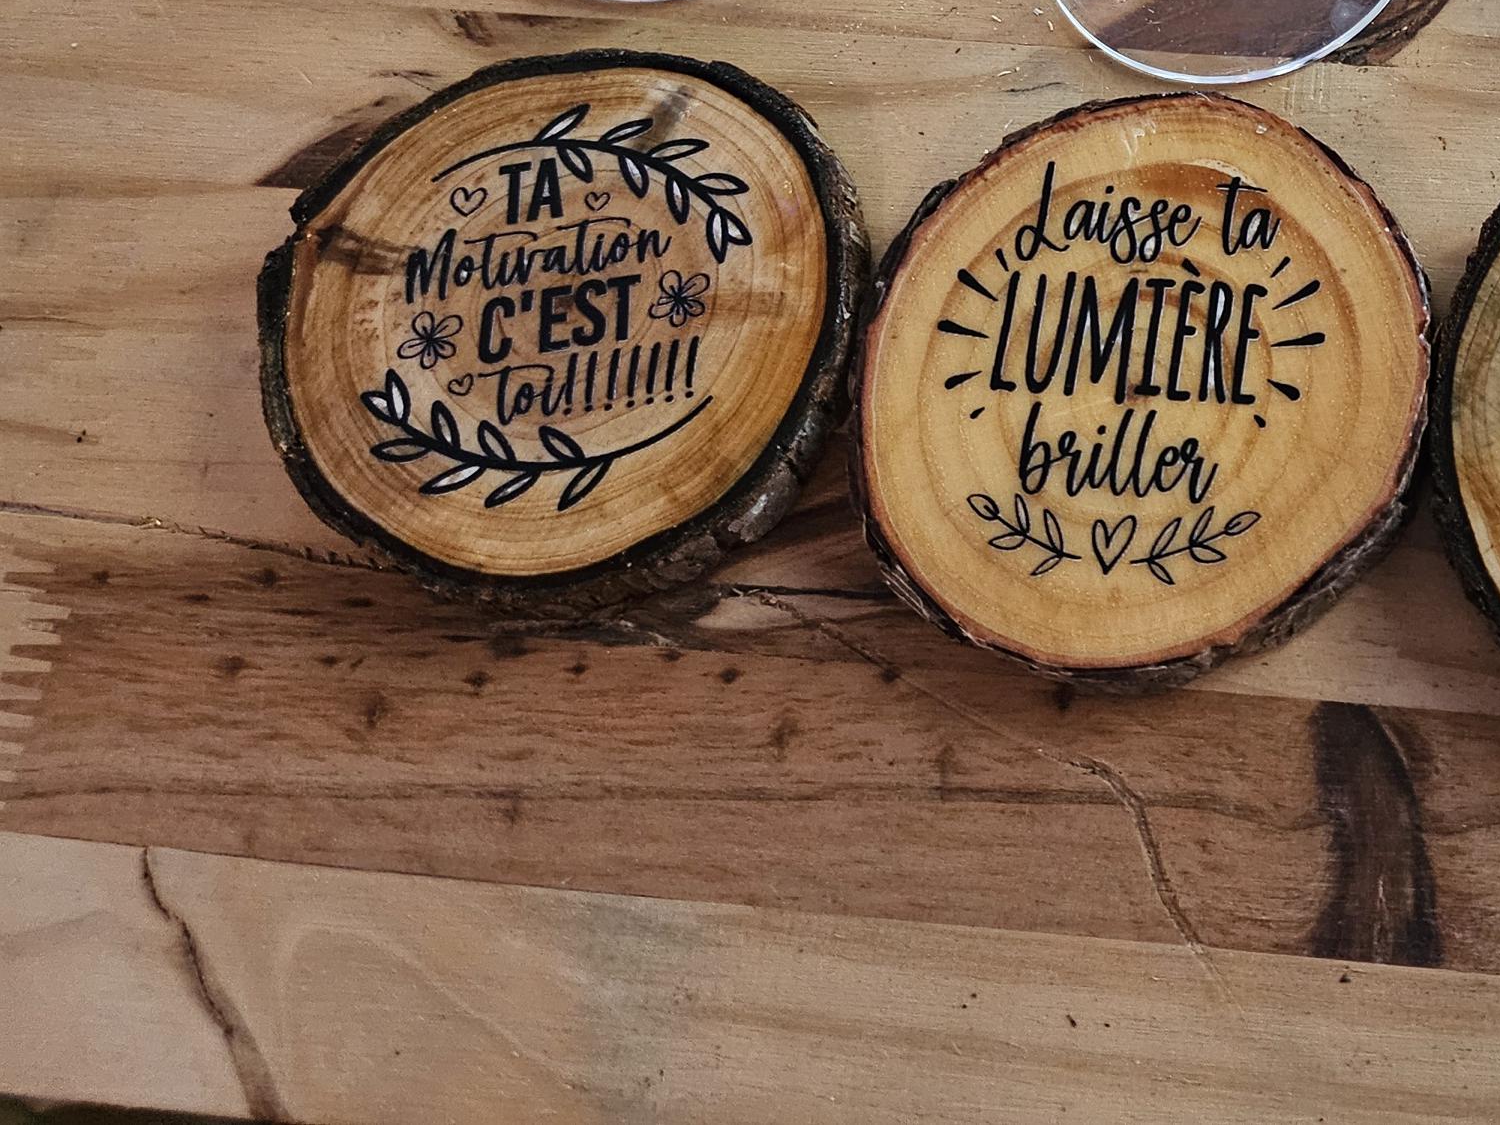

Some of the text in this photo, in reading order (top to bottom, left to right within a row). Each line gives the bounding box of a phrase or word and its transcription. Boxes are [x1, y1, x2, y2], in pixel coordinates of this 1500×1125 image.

[500, 158, 563, 225] TA
[1014, 161, 1282, 264] Laisse ta
[406, 216, 671, 304] Motivation
[478, 274, 641, 363] C'EST
[989, 259, 1268, 404] LUMIÈRE
[1018, 401, 1218, 503] briller
